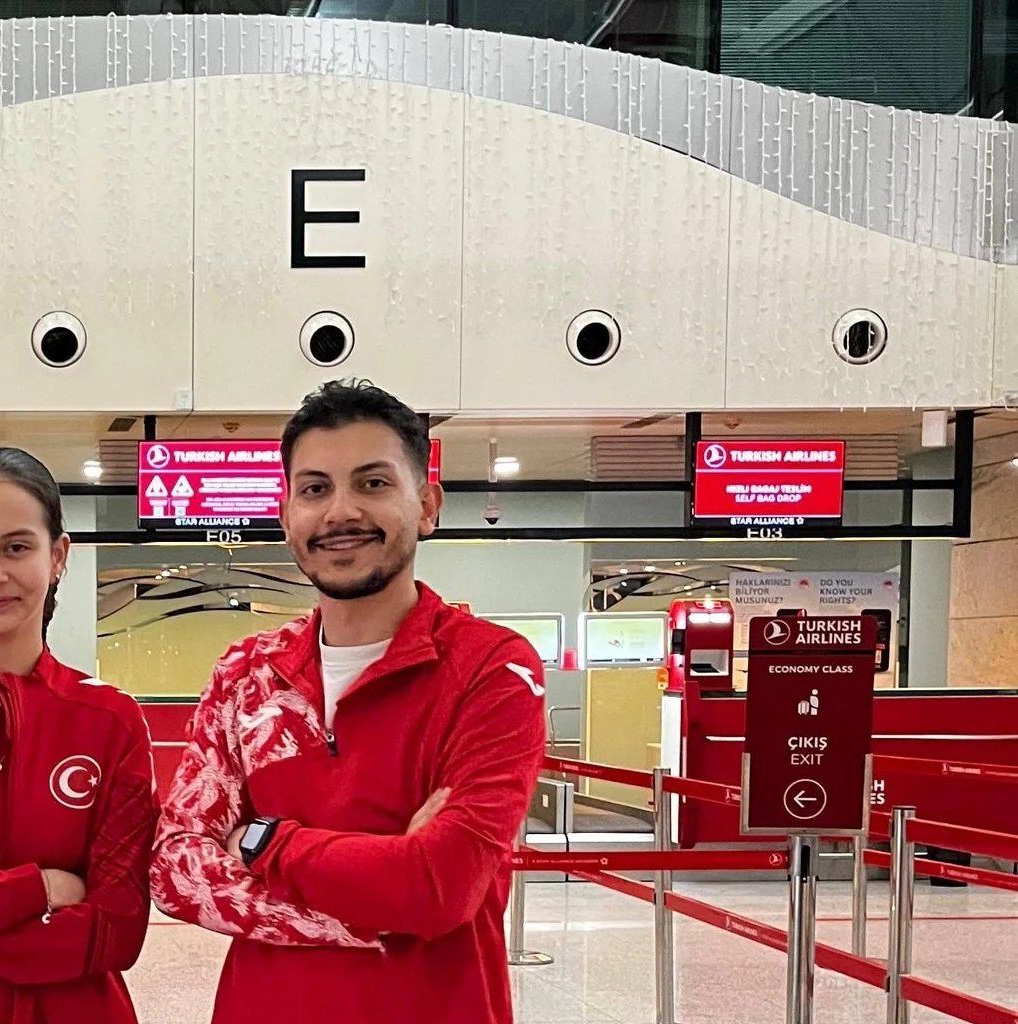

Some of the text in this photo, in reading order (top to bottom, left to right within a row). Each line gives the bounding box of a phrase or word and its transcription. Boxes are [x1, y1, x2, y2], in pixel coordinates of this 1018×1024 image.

[291, 168, 366, 269] E
[173, 450, 281, 463] TURKISH AIRLINES
[729, 450, 836, 462] TURKISH AIRLINES
[725, 484, 749, 493] HIZLI
[735, 494, 802, 503] SELF BAG DROP
[175, 518, 240, 526] STAR ALLIANCE
[730, 517, 795, 525] STAR ALLIANCE
[206, 530, 242, 543] E05
[747, 527, 783, 539] E03
[735, 578, 791, 586] HAKLARINIZI
[735, 587, 770, 595] BİLİYOR
[819, 588, 873, 596] KNOW YOUR
[735, 596, 784, 604] MUSUNUZ?
[819, 596, 857, 604] RIGHTS?
[796, 620, 862, 632] TURKISH
[795, 632, 862, 644] AIRLINES
[768, 665, 854, 674] ECONOMY CLASS
[787, 736, 828, 751] ÇIKIŞ
[790, 753, 824, 765] EXIT
